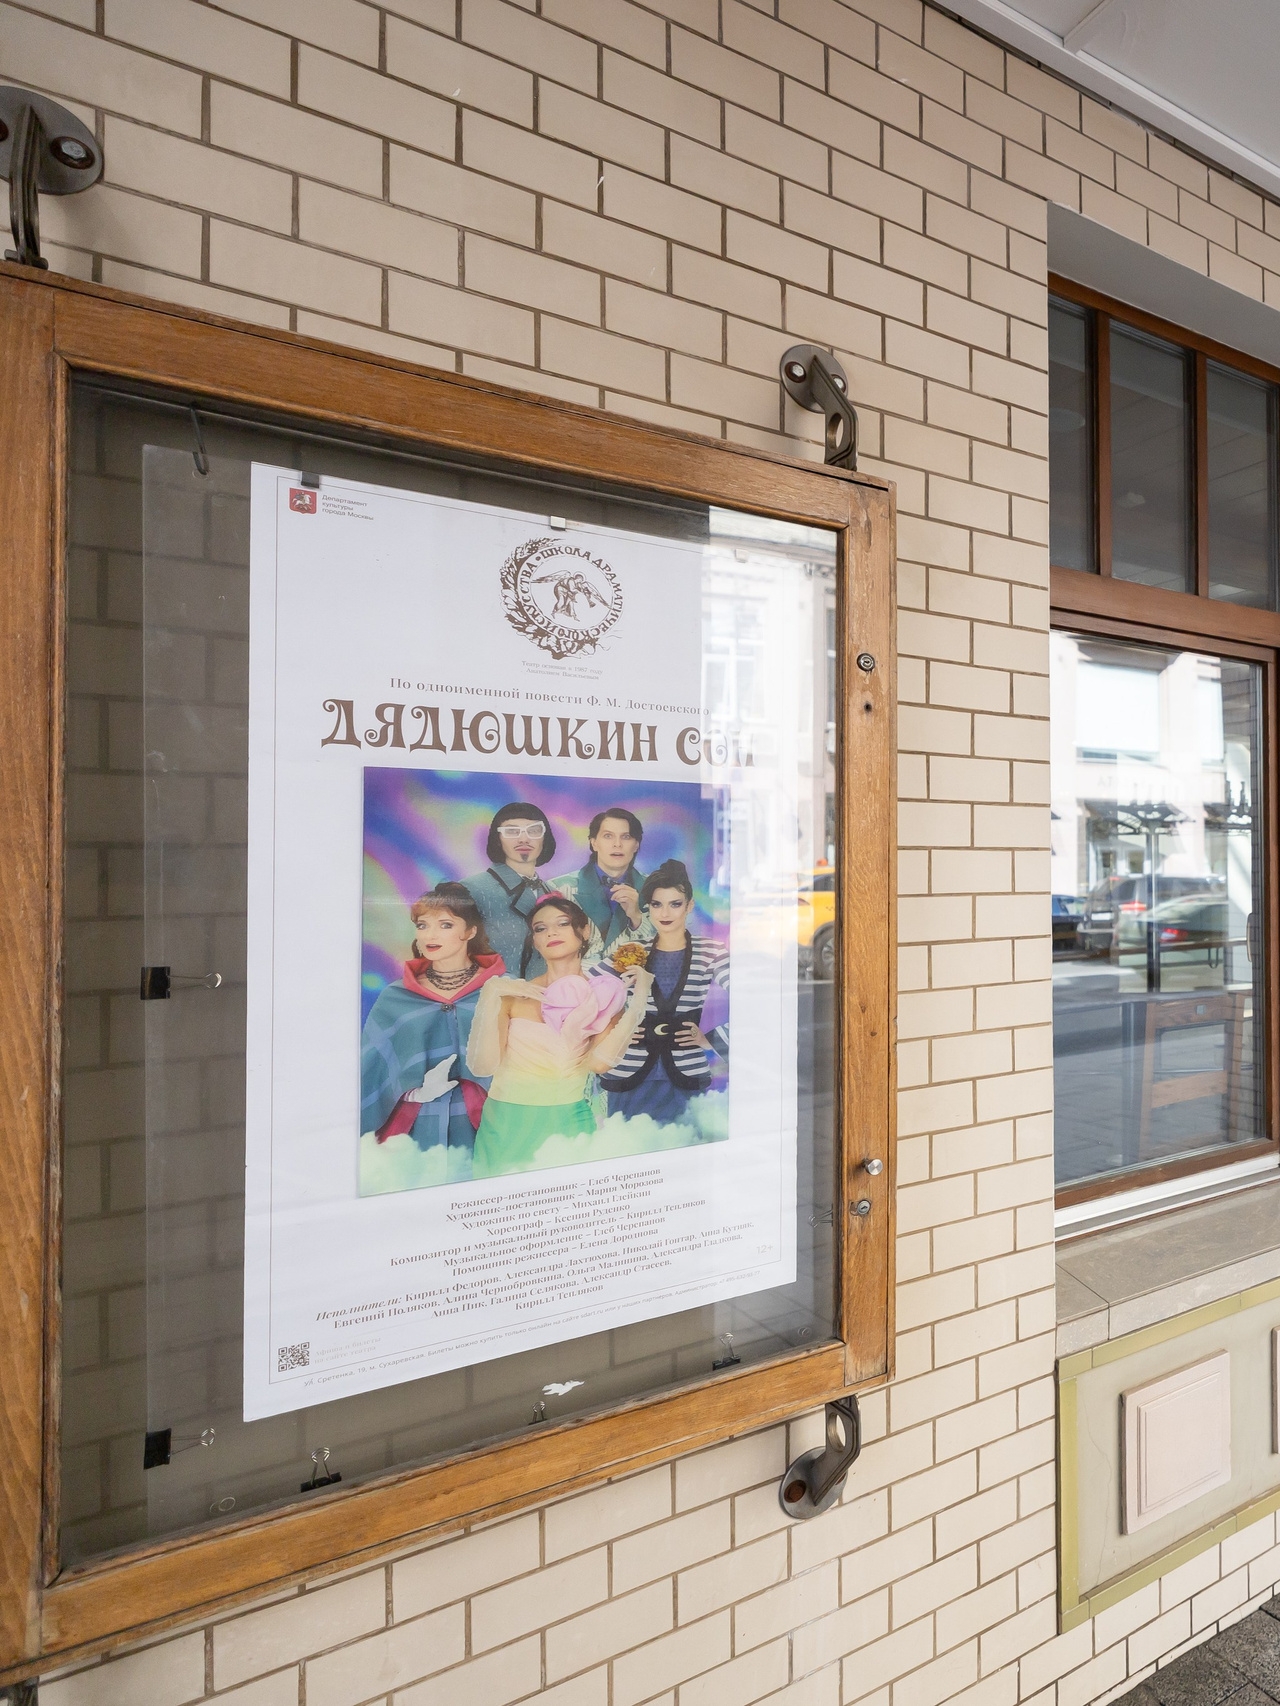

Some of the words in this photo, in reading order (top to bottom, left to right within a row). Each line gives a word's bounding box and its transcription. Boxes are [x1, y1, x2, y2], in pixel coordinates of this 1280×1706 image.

[321, 493, 368, 508] Департамент
[321, 501, 354, 512] культуры
[321, 507, 345, 517] города
[347, 511, 374, 521] Москвы
[542, 546, 591, 561] ШКОЛА
[390, 677, 411, 689] По
[416, 682, 519, 698] одноименной
[525, 692, 582, 704] повести
[586, 694, 601, 706] Ф.
[605, 697, 621, 708] М.
[625, 699, 709, 716] Достоевского
[320, 698, 658, 763] ДЯДЮШКИН
[446, 1193, 574, 1221] Художник-постановщик
[585, 1185, 617, 1196] Мария
[619, 1177, 663, 1190] Морозова
[450, 1182, 577, 1210] Режиссер-постановщик
[588, 1175, 609, 1186] Глеб
[611, 1168, 660, 1182] Черепанов
[461, 1214, 515, 1230] Художник
[517, 1211, 531, 1219] по
[532, 1206, 560, 1217] свету
[571, 1197, 609, 1209] Михаил
[611, 1189, 650, 1202] Глейкин
[486, 1219, 543, 1236] Хореограф
[554, 1211, 590, 1223] Ксения
[592, 1204, 630, 1217] Руденко
[390, 1247, 461, 1266] Композитор
[463, 1244, 470, 1252] и
[473, 1228, 547, 1250] музыкальный
[549, 1216, 616, 1236] руководитель
[626, 1207, 662, 1219] Кирилл
[663, 1199, 705, 1212] Тепляков
[444, 1246, 517, 1266] Музыкальное
[519, 1233, 583, 1251] оформление
[593, 1224, 615, 1236] Глеб
[616, 1216, 665, 1231] Черепанов
[755, 1241, 773, 1255] 12+
[452, 1258, 512, 1276] Помощник
[514, 1246, 569, 1264] режиссера
[579, 1238, 608, 1249] Елена
[334, 1309, 384, 1328] Евгений
[442, 1291, 477, 1304] Алина
[433, 1306, 459, 1317] Анна
[515, 1295, 554, 1310] Кирилл
[556, 1284, 603, 1299] Тепляков
[317, 1368, 355, 1384] Сретенка,
[357, 1365, 368, 1374] 19,
[427, 1344, 453, 1356] Билеты
